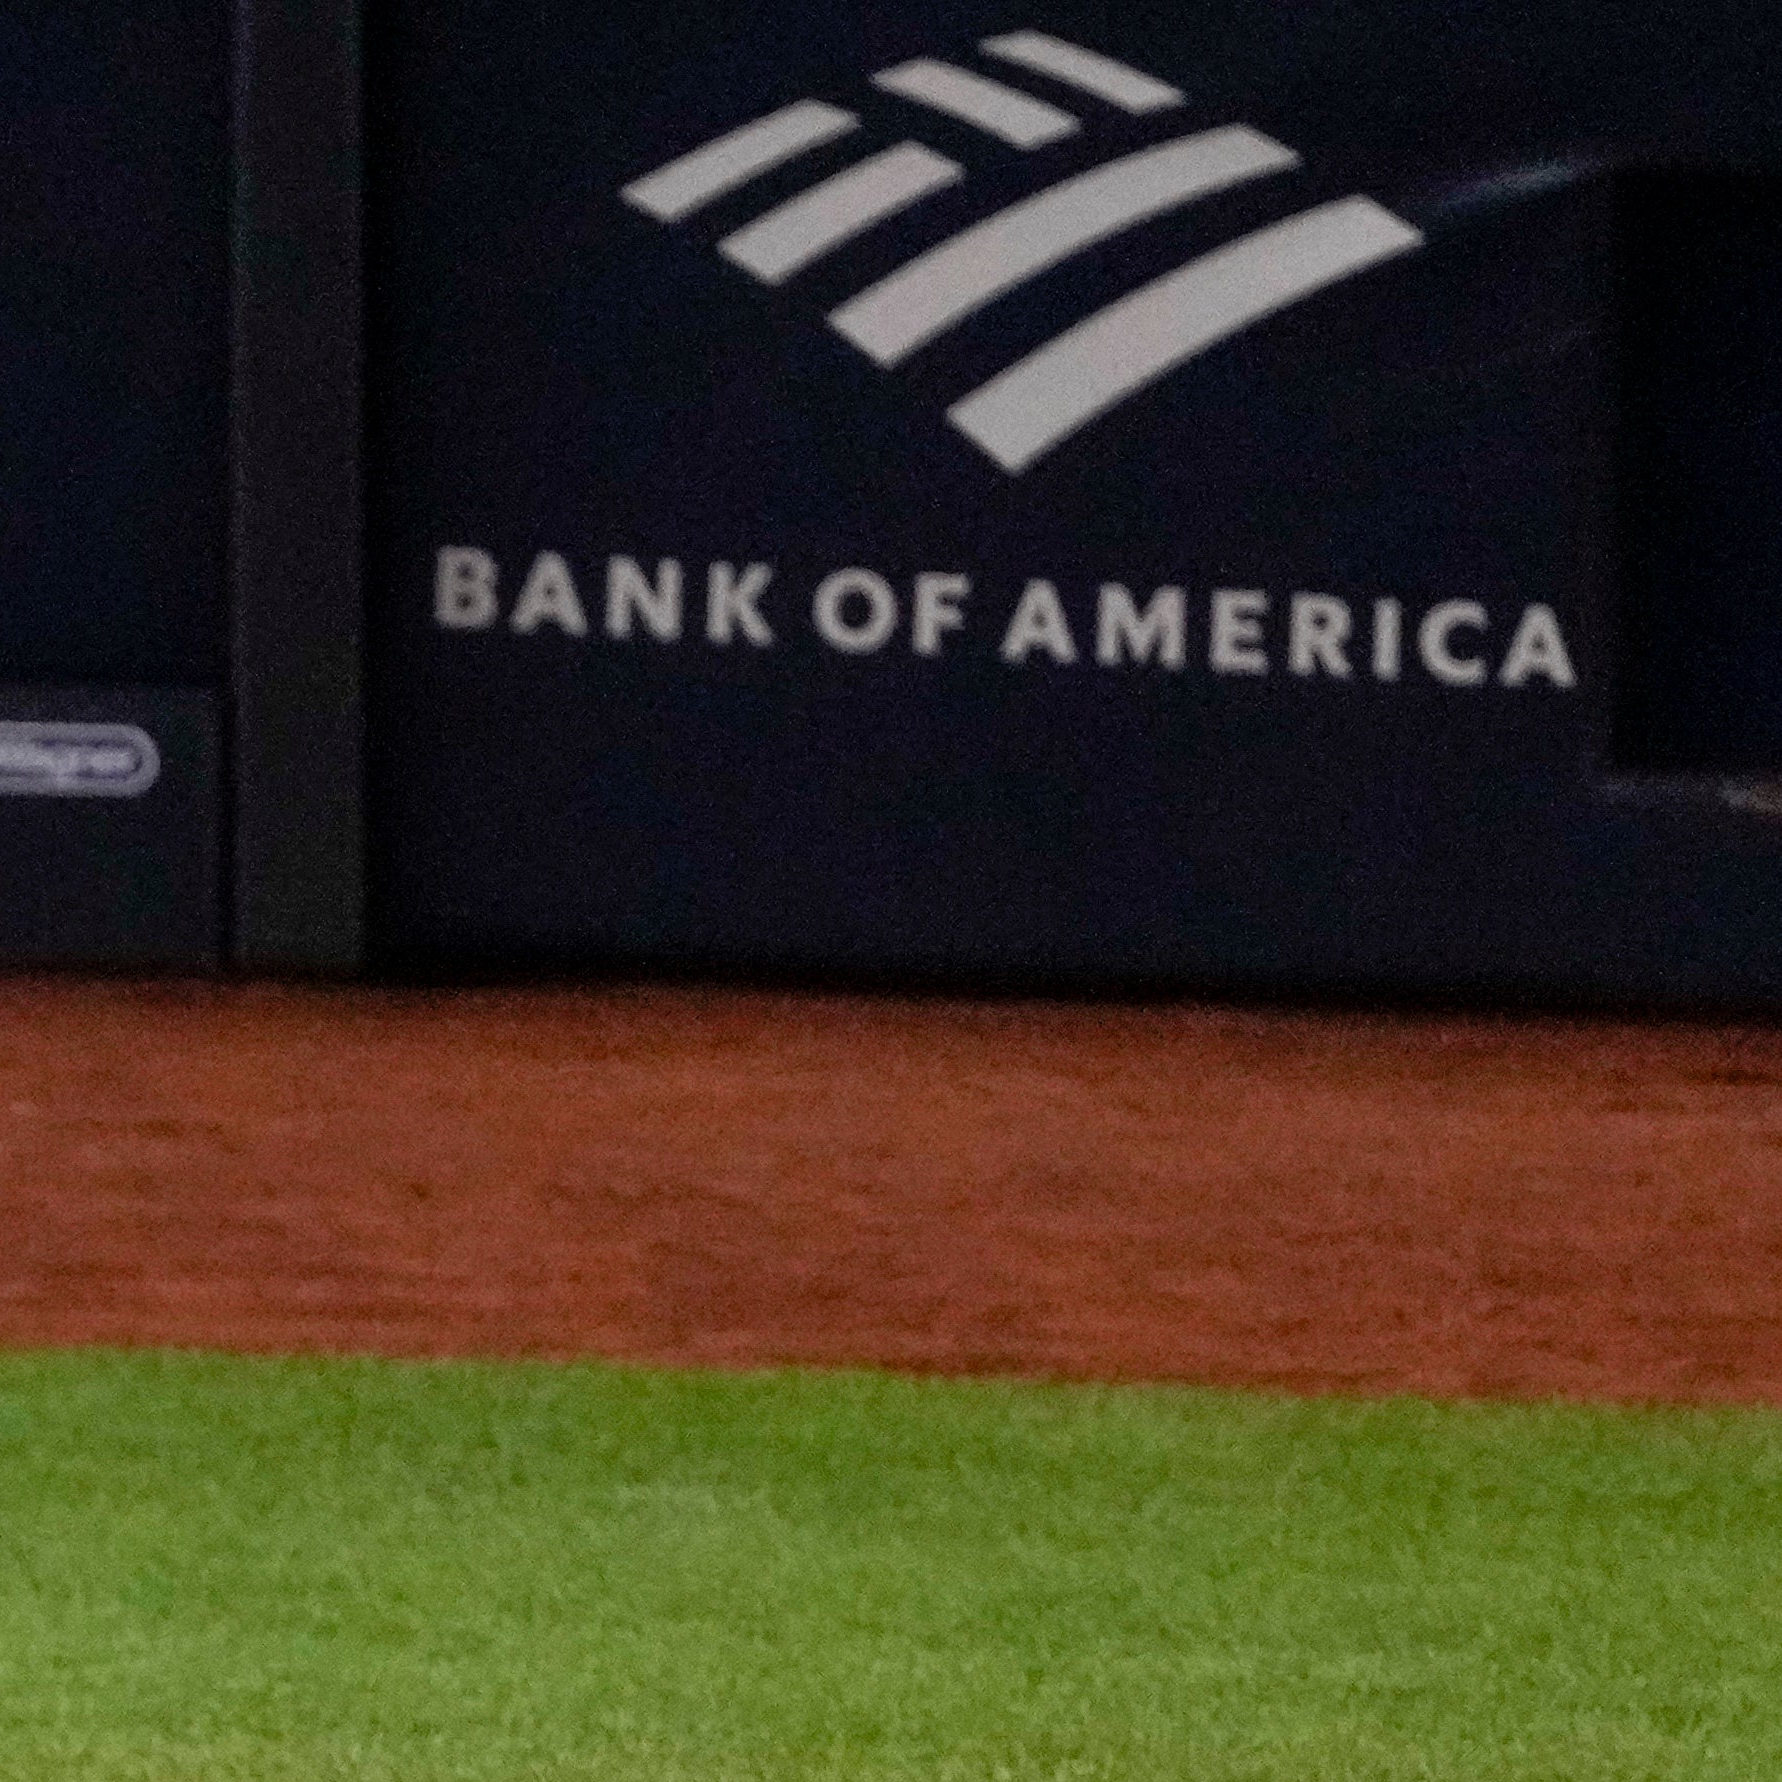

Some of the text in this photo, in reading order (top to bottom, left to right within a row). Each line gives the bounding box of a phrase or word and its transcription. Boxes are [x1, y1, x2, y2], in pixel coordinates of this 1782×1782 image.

[436, 547, 1576, 689] BANK OF AMERICA
